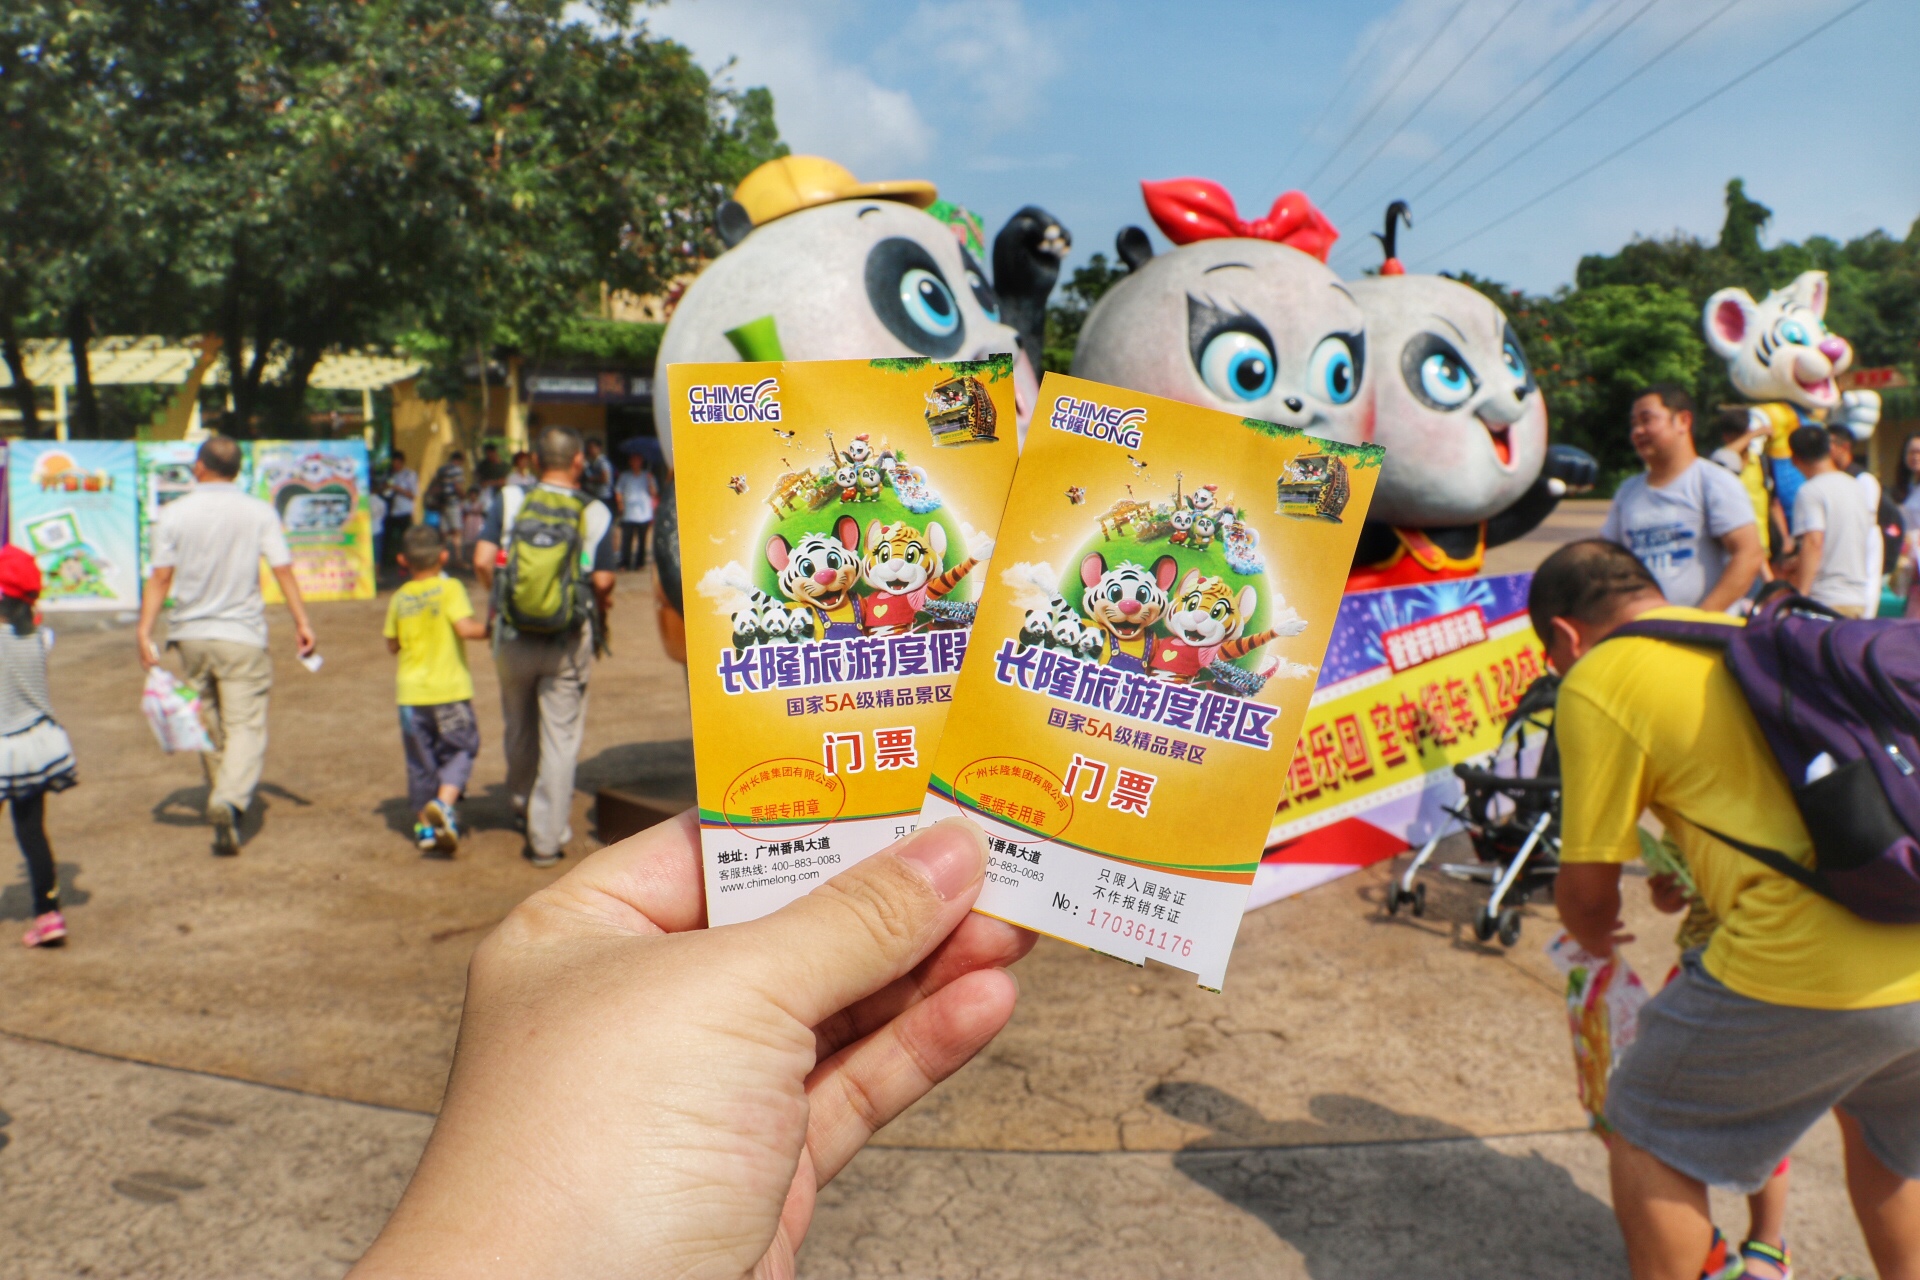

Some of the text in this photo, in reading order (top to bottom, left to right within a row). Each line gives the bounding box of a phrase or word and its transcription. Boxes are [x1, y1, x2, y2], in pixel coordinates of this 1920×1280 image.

[787, 685, 952, 716] 国家5A级精品景区
[996, 641, 1278, 748] 长隆旅游度假区
[825, 729, 915, 773] 门票
[1047, 707, 1207, 765] 国家5A级精品景区
[730, 766, 838, 804] 广州长隆集团有限公司
[964, 764, 1069, 811] 广州长隆集团有限公司
[1065, 757, 1155, 815] 门票
[750, 798, 821, 824] 票据专用章
[977, 793, 1047, 827] 票据专用章
[720, 869, 820, 893] www.chimelong.com
[984, 869, 1020, 888] ng.com
[1097, 868, 1188, 906] 只限入园验证
[1092, 885, 1182, 924] 不作报销凭证
[1087, 908, 1194, 957] 170361176
